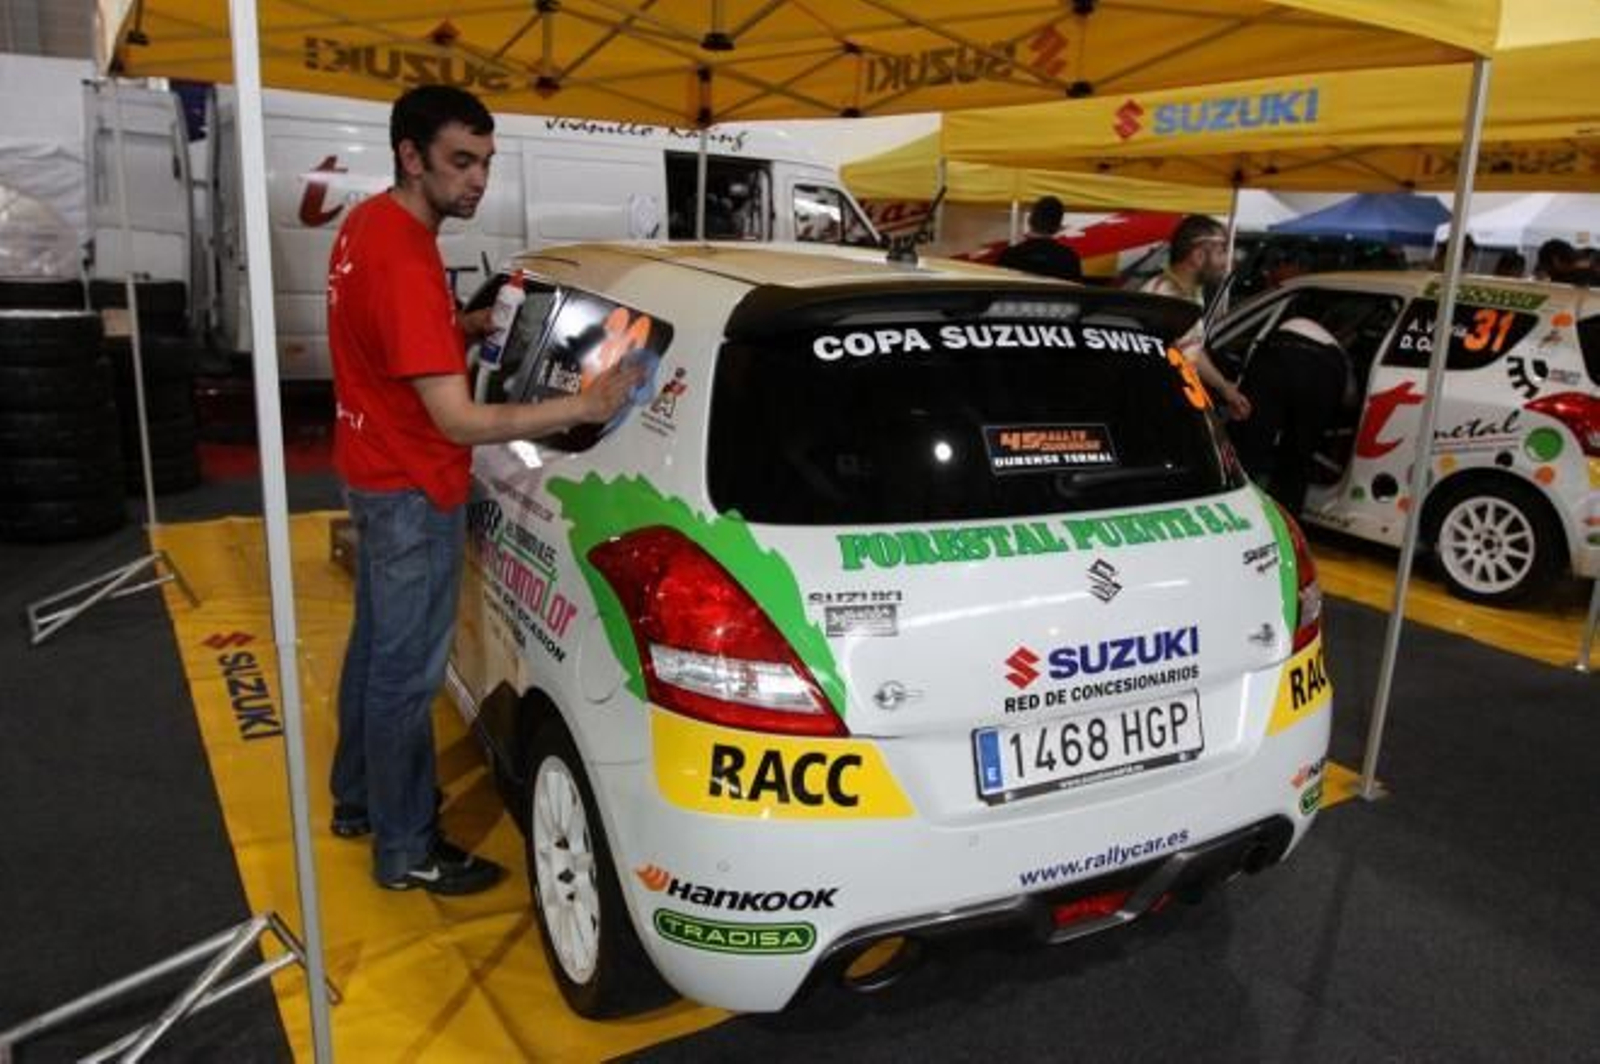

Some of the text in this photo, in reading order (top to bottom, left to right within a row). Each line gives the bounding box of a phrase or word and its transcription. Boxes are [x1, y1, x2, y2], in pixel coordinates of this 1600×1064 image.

[1153, 88, 1319, 134] SUZUKI
[813, 325, 1166, 361] COPA SUZUKI SWIFT
[1463, 308, 1514, 352] 31
[836, 521, 1069, 571] FORESTAL
[1062, 508, 1205, 551] PUENTE
[1048, 627, 1200, 680] SUZUKI
[218, 651, 284, 741] SUZUKI
[1004, 665, 1200, 714] RED DE CONCESIONARIOS
[1010, 717, 1108, 778] 1468
[1121, 701, 1190, 755] HGP
[708, 743, 862, 808] RACC
[1018, 829, 1189, 886] www.rallycar.es
[664, 918, 803, 947] TRADISA
